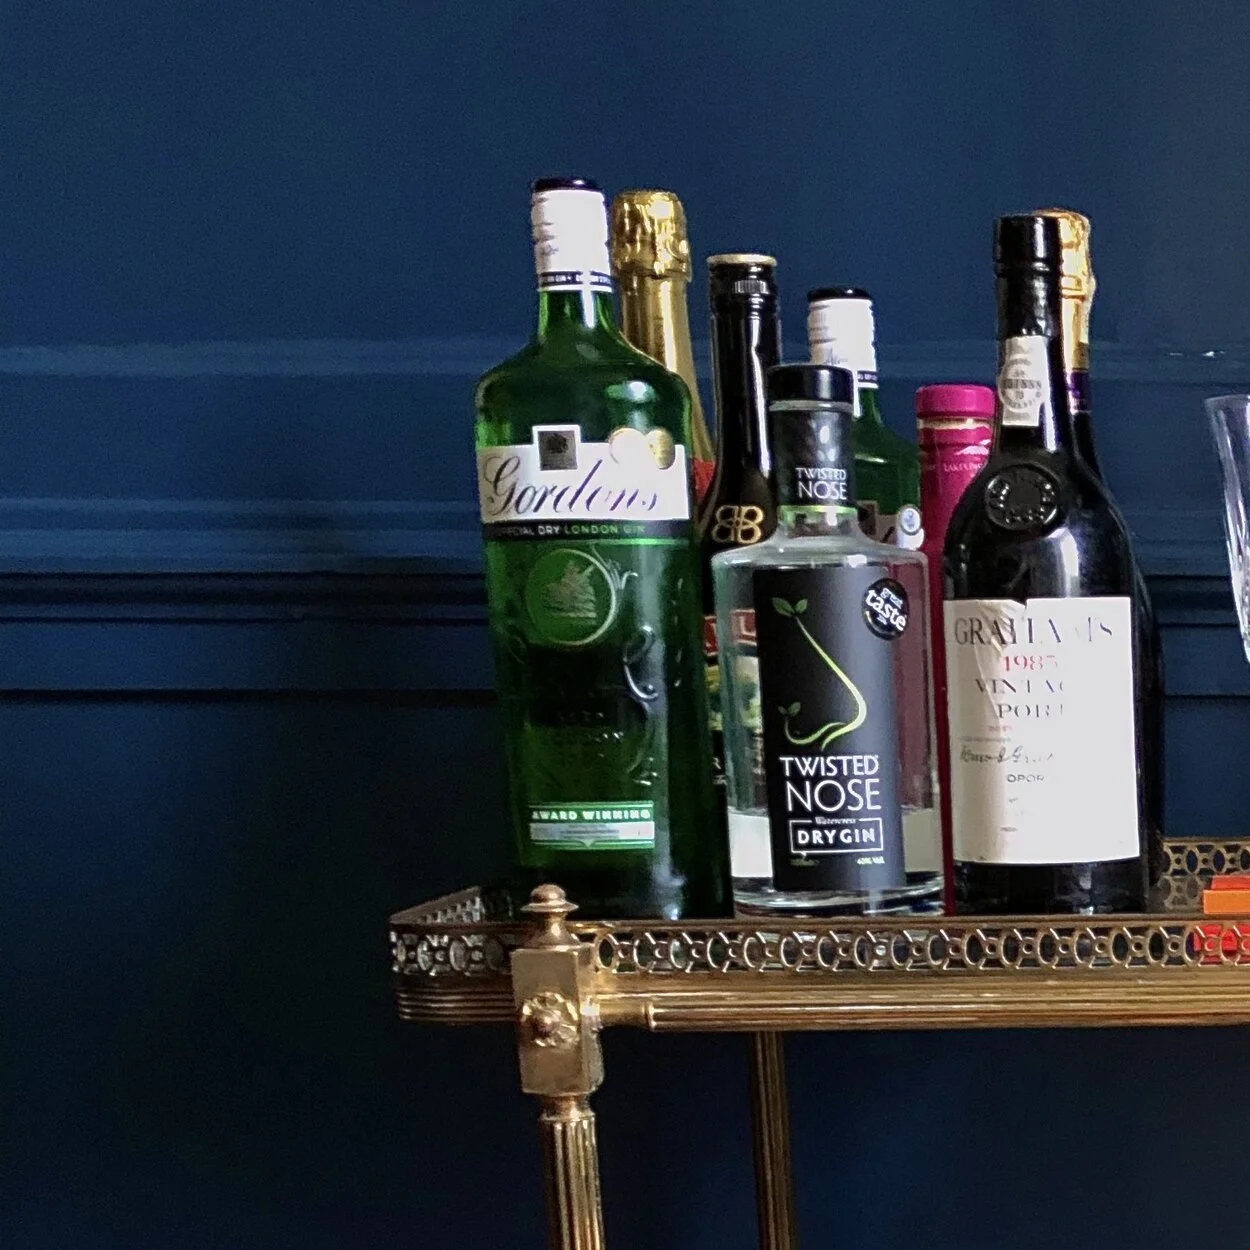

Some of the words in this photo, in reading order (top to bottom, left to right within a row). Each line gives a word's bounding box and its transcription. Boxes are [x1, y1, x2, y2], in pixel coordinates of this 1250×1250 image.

[796, 467, 846, 480] TWISTED
[798, 481, 847, 500] NOSE
[500, 525, 535, 536] PECIAL
[538, 525, 560, 535] DRY
[564, 524, 618, 535] LONDON
[865, 589, 906, 631] taste
[955, 616, 1112, 645] GRAHAS
[779, 754, 879, 776] TWISTED
[786, 778, 882, 812] NOSE
[532, 810, 578, 820] AWARD
[582, 809, 651, 820] WINNING
